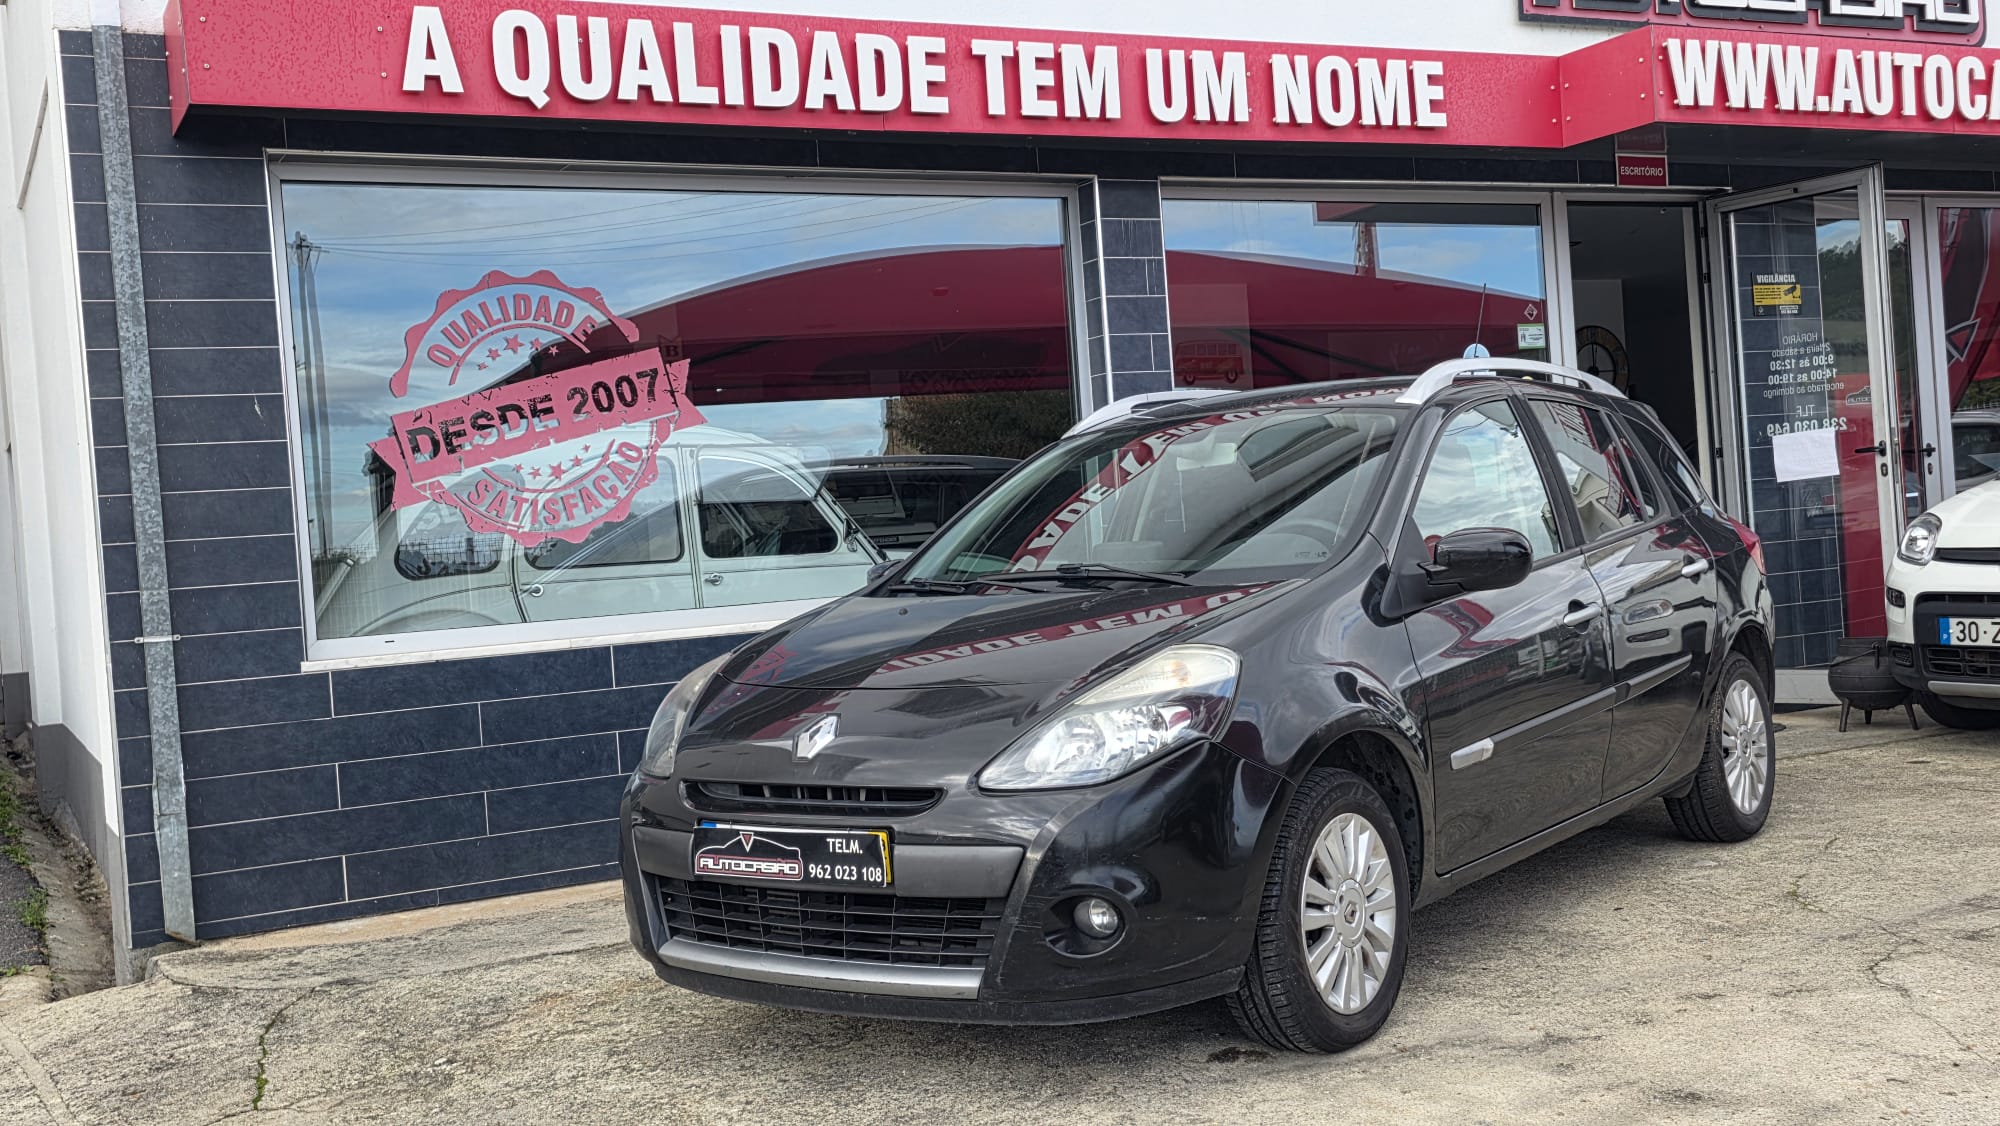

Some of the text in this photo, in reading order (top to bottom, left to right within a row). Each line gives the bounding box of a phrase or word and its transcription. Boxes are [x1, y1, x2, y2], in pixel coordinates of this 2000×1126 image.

[402, 5, 1448, 128] A QUALIDADE TEM UM NOME
[1620, 165, 1664, 177] ESCRITÓRIO
[1756, 273, 1796, 284] VIGILÂNCIA
[427, 293, 600, 368] QUALIDADE
[405, 368, 660, 466] DESDE 2007
[826, 838, 863, 854] TELM.
[809, 863, 882, 882] 962 023 108
